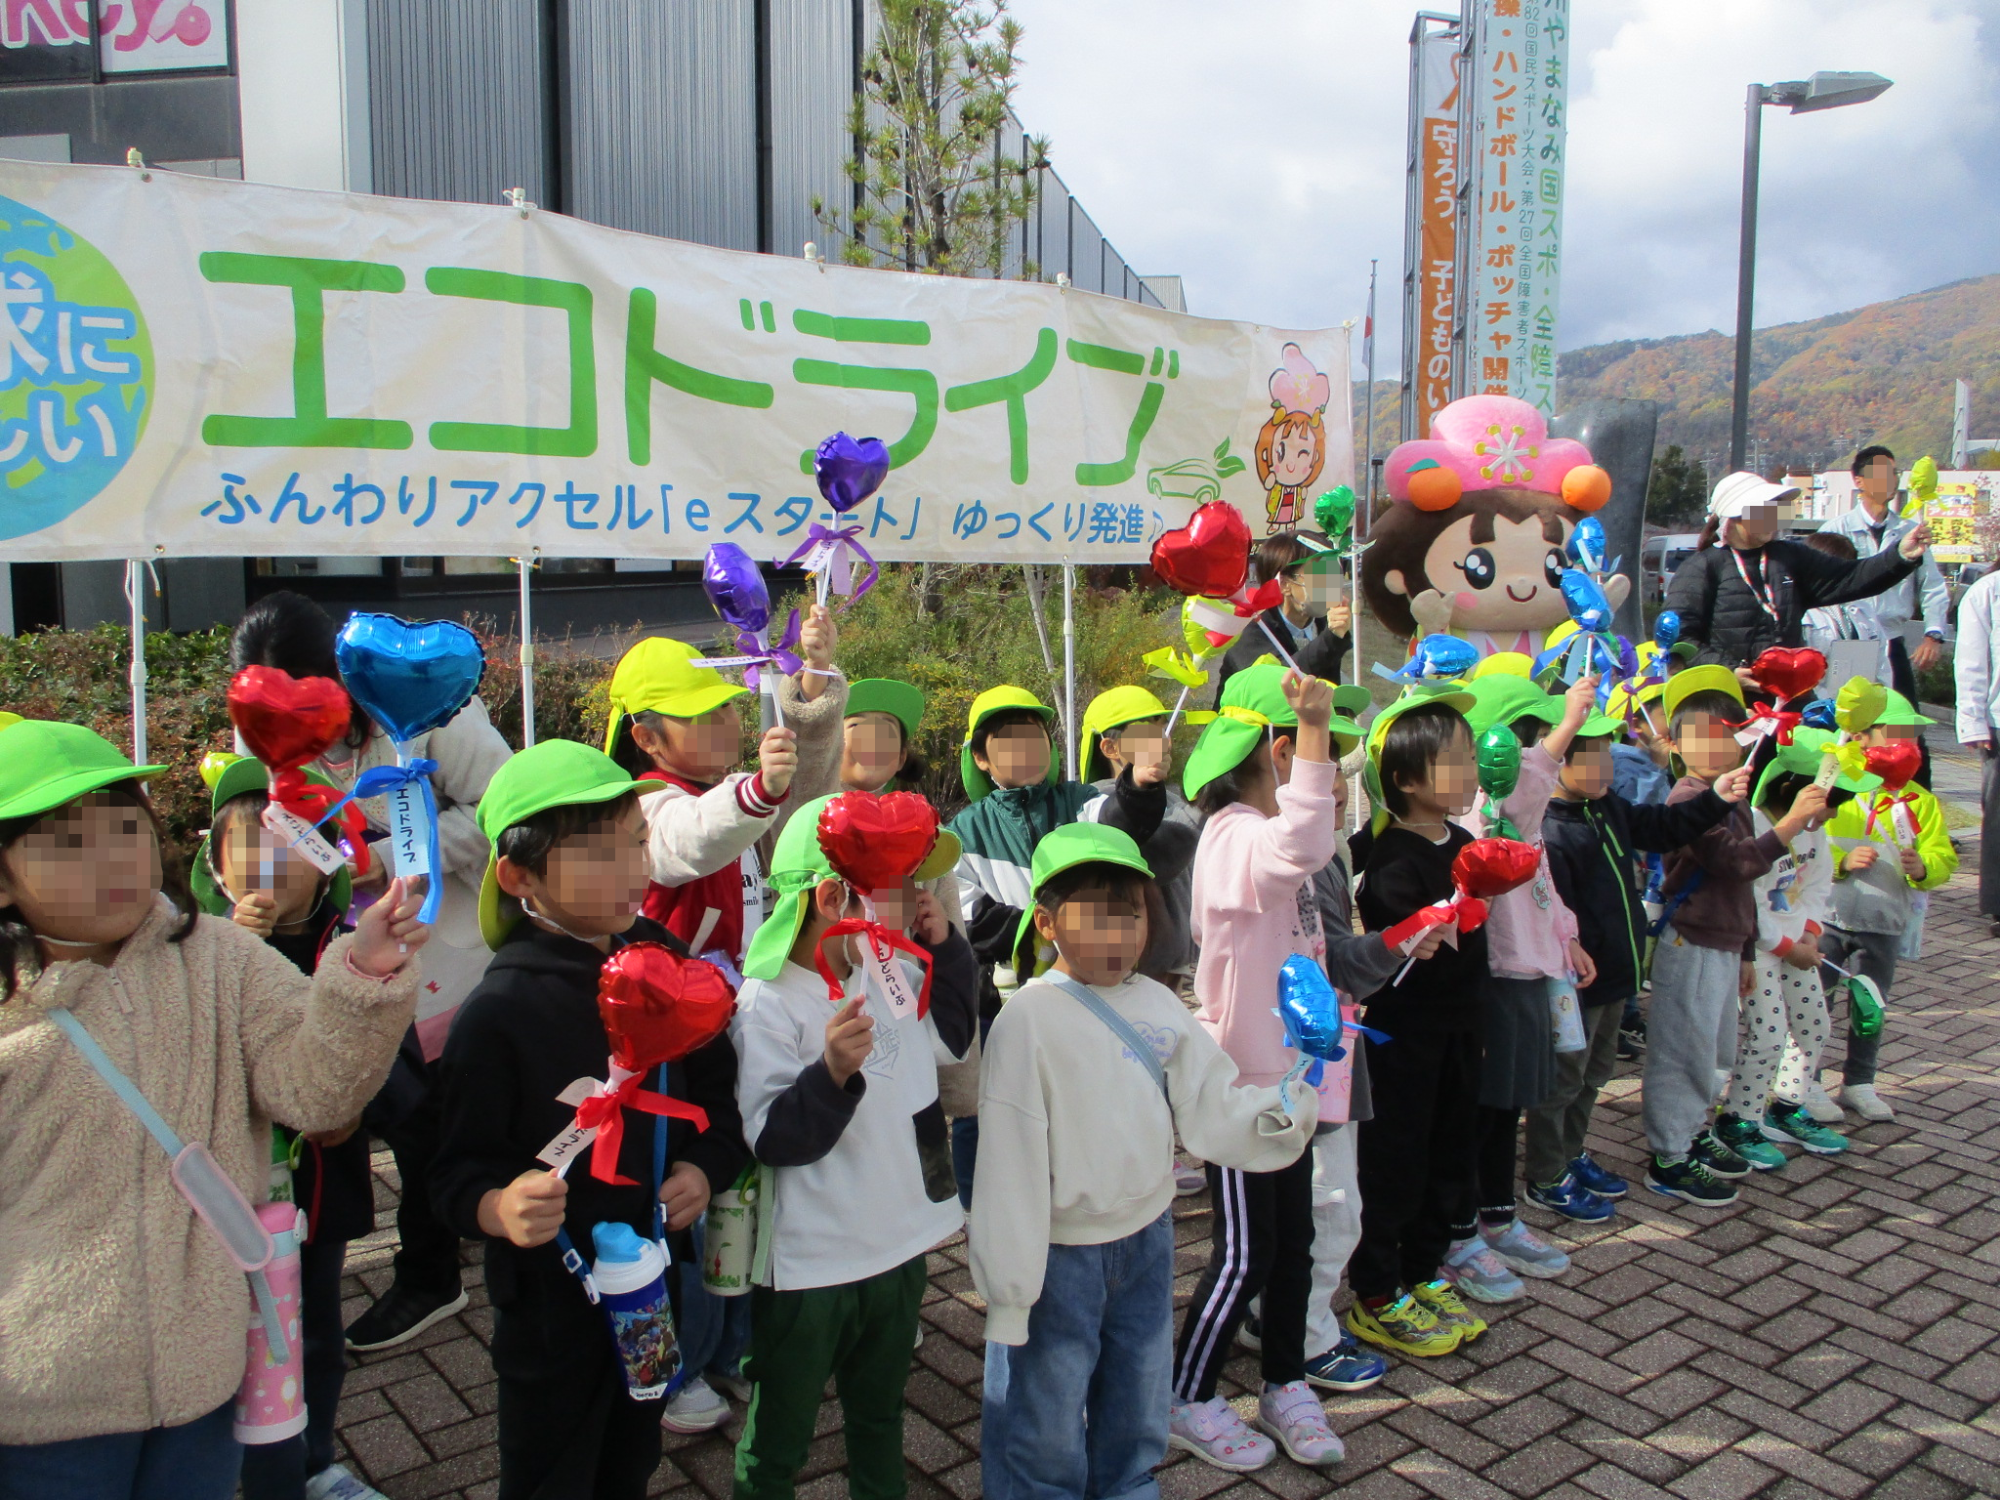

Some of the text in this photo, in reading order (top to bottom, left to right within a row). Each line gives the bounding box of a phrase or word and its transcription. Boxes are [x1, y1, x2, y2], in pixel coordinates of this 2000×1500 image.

[199, 251, 1180, 486] エコドライブ
[953, 500, 1144, 544] ゆっくり発進
[397, 788, 416, 863] エコドライブ
